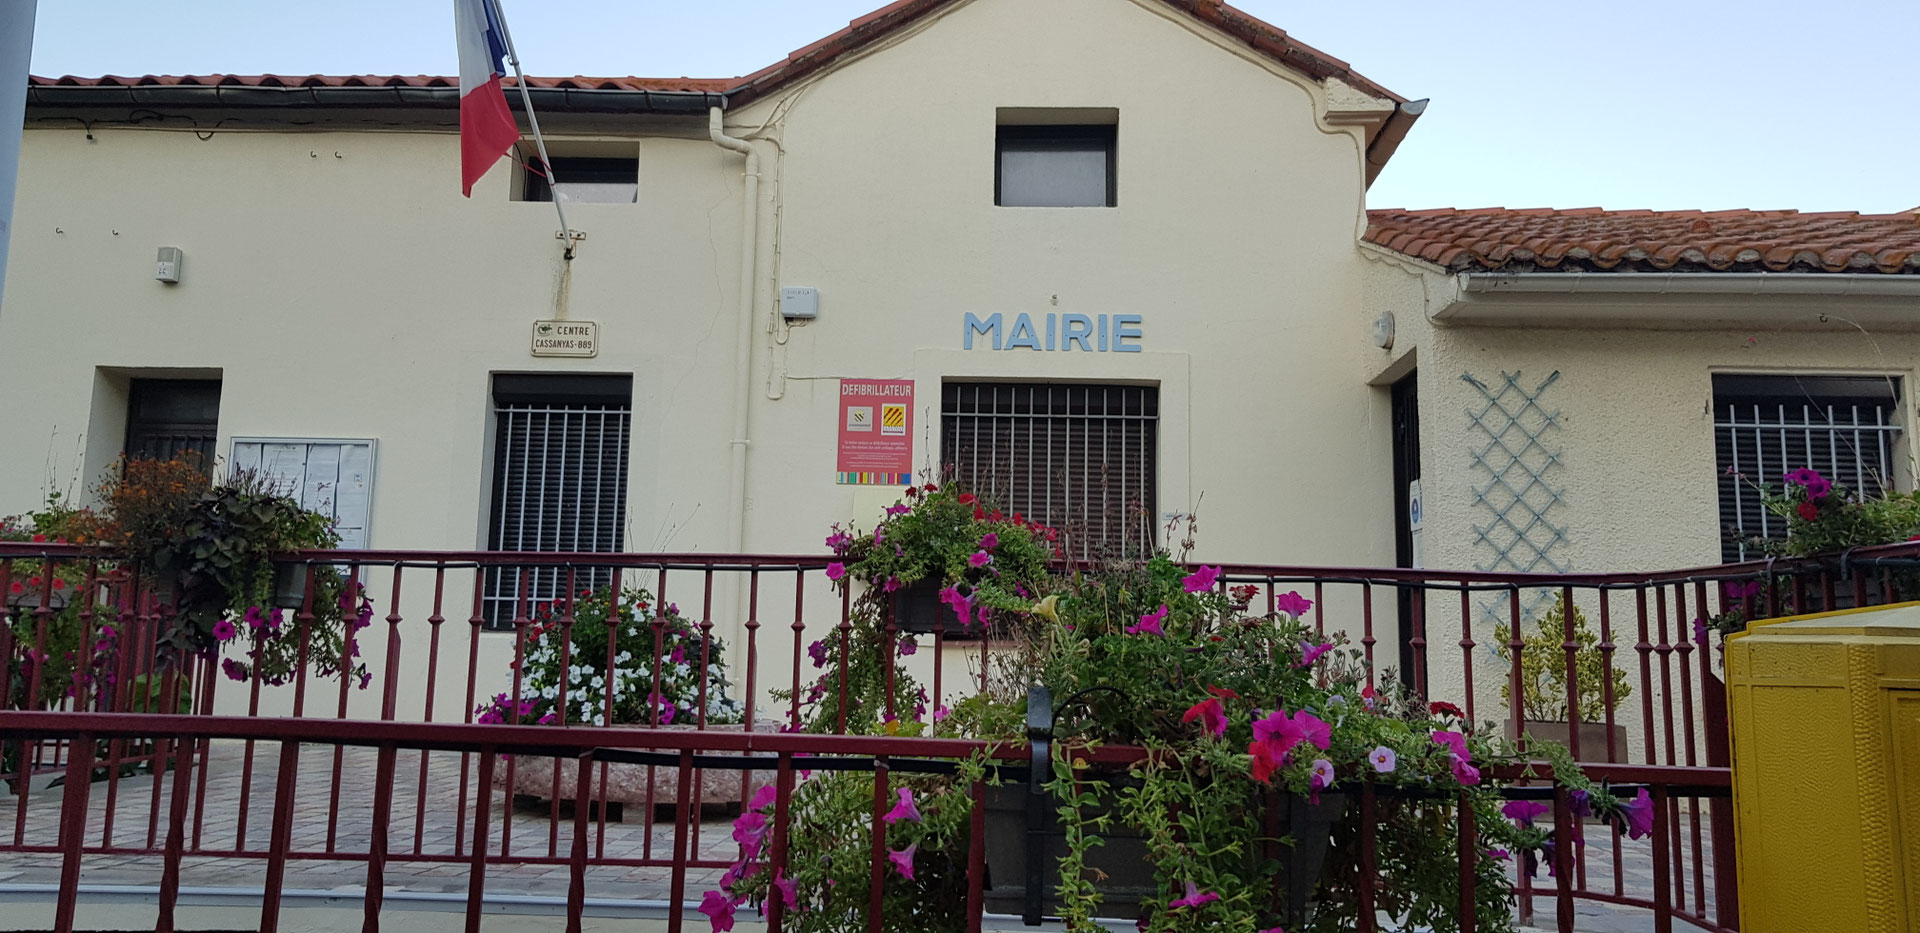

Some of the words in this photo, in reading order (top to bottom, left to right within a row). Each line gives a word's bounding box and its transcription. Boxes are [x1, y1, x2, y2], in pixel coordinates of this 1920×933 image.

[557, 326, 590, 336] CENTRE
[963, 311, 1143, 353] MAIRIE
[842, 383, 912, 397] DEFIBRILLATEUR
